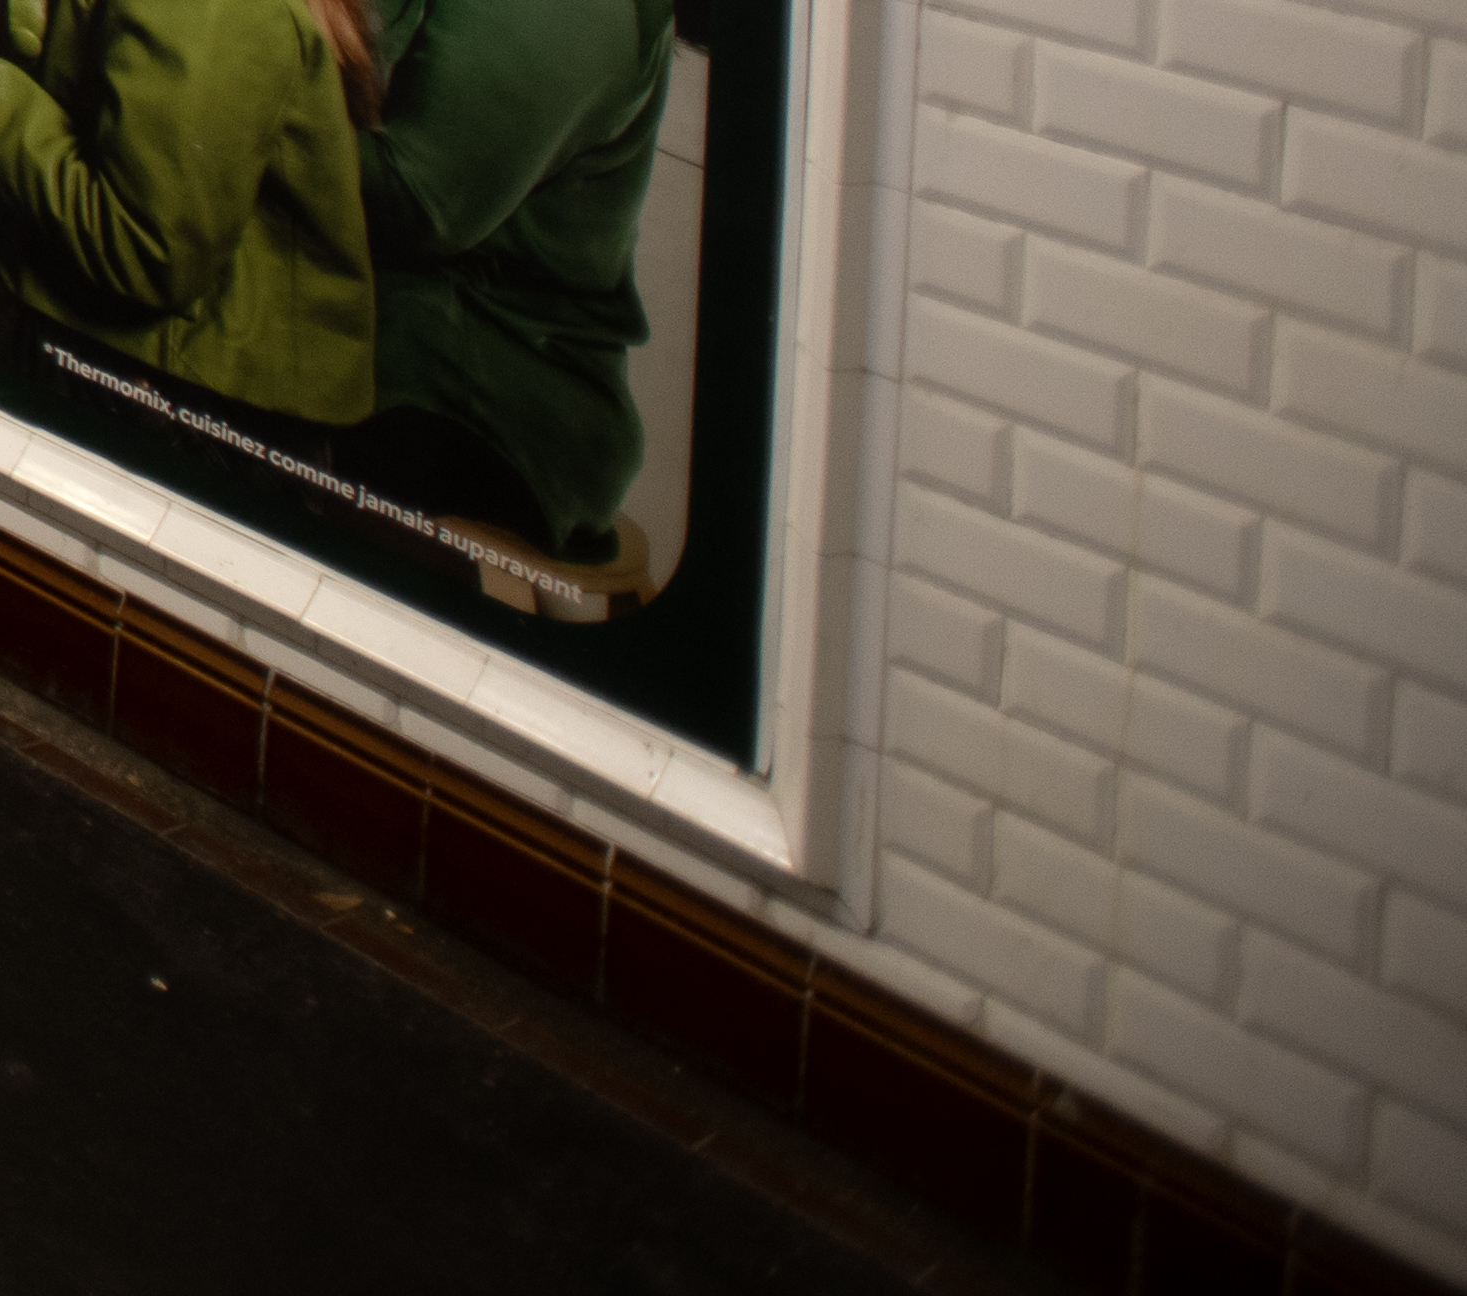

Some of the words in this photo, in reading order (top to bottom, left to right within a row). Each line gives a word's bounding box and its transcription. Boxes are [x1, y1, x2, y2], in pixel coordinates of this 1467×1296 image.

[178, 407, 266, 460] cuisinez
[268, 449, 354, 500] comme
[357, 485, 435, 537] jamais
[438, 527, 583, 604] auparavant
